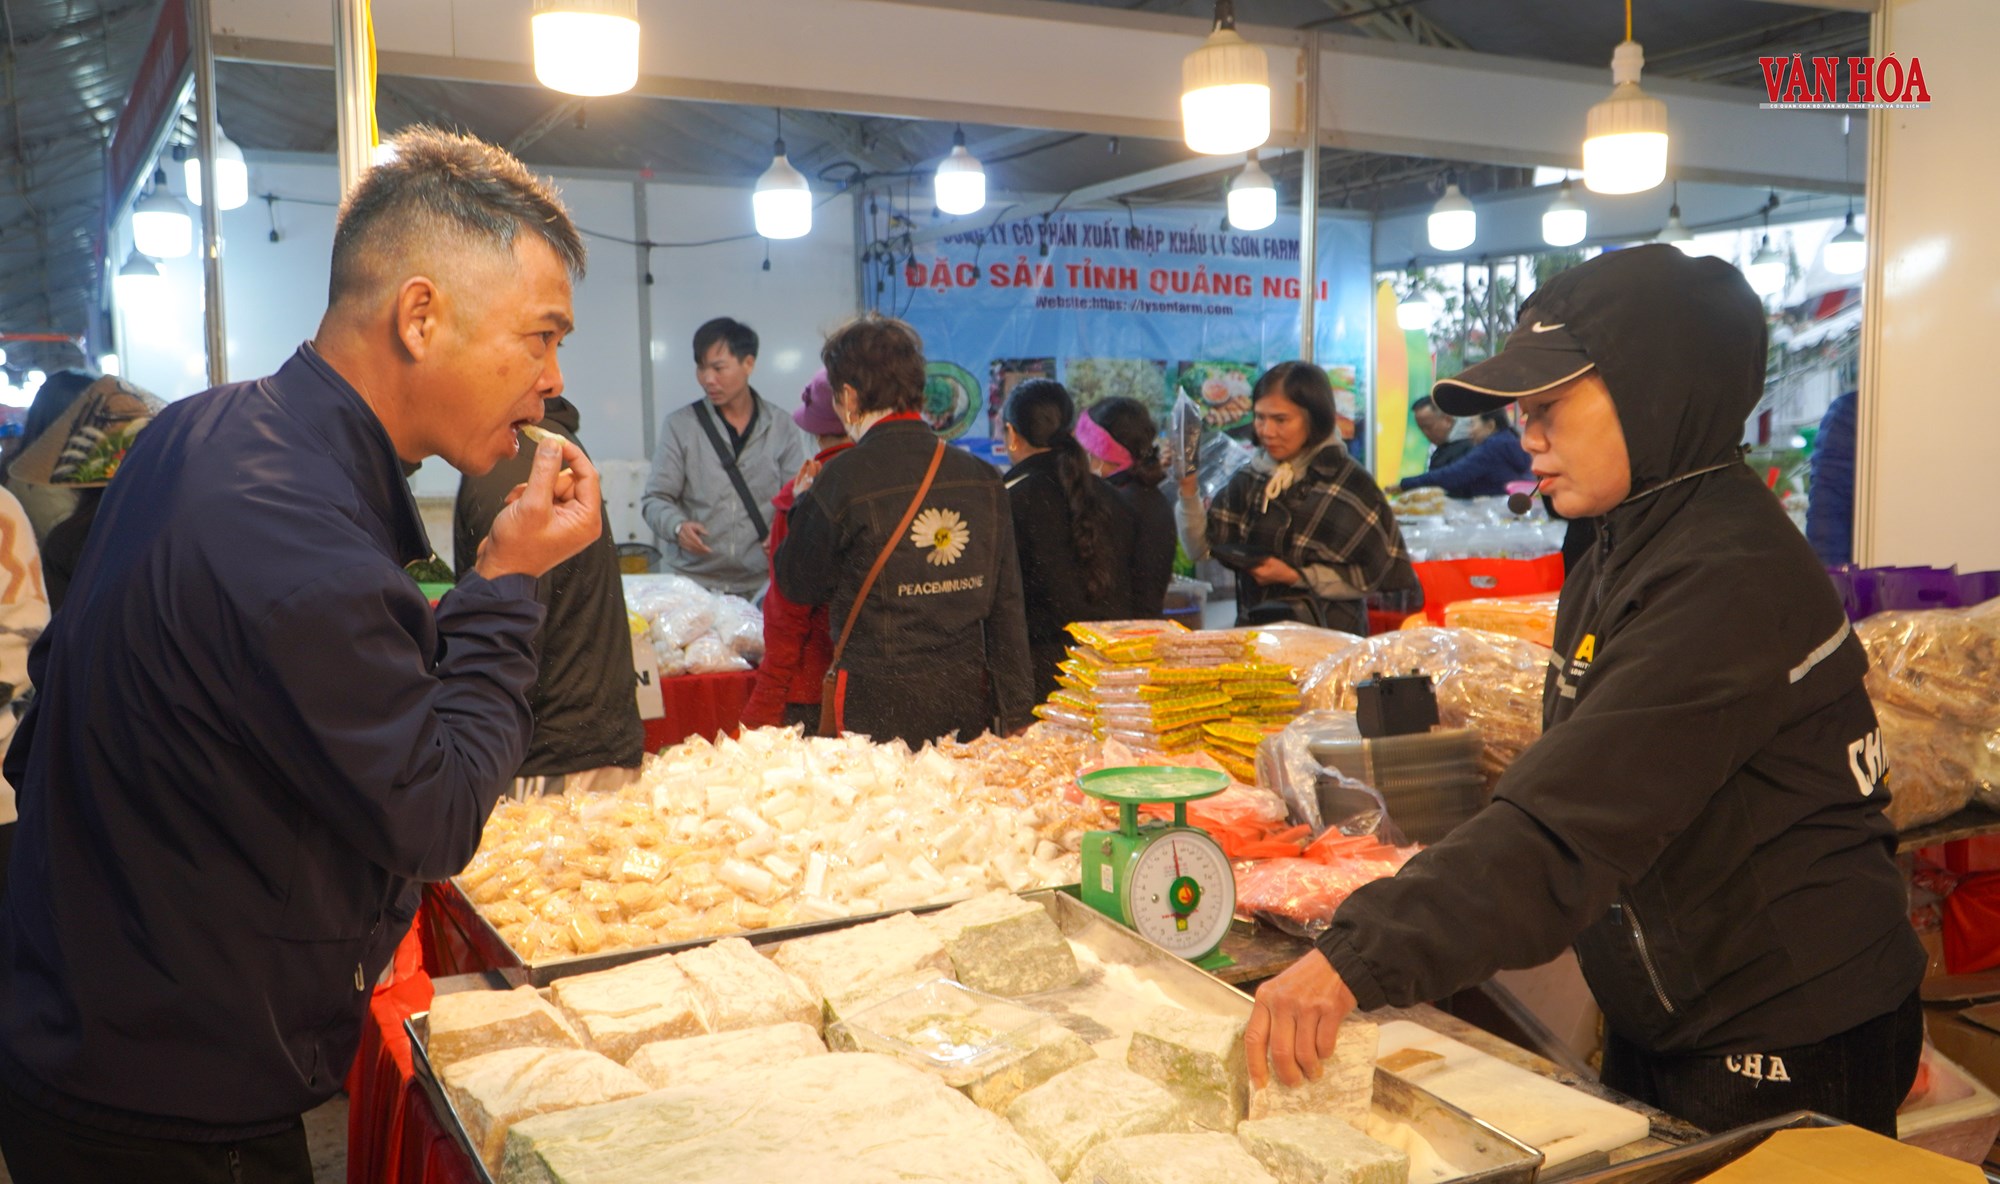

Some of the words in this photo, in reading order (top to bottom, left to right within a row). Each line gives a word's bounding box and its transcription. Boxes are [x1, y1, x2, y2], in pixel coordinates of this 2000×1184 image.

[1264, 237, 1300, 261] FARM
[905, 257, 979, 293] ĐẶC
[989, 255, 1056, 288] SẢN
[1066, 257, 1138, 290] TỈNH
[1150, 264, 1252, 297] QUẢNG
[1726, 1053, 1791, 1082] CHA
